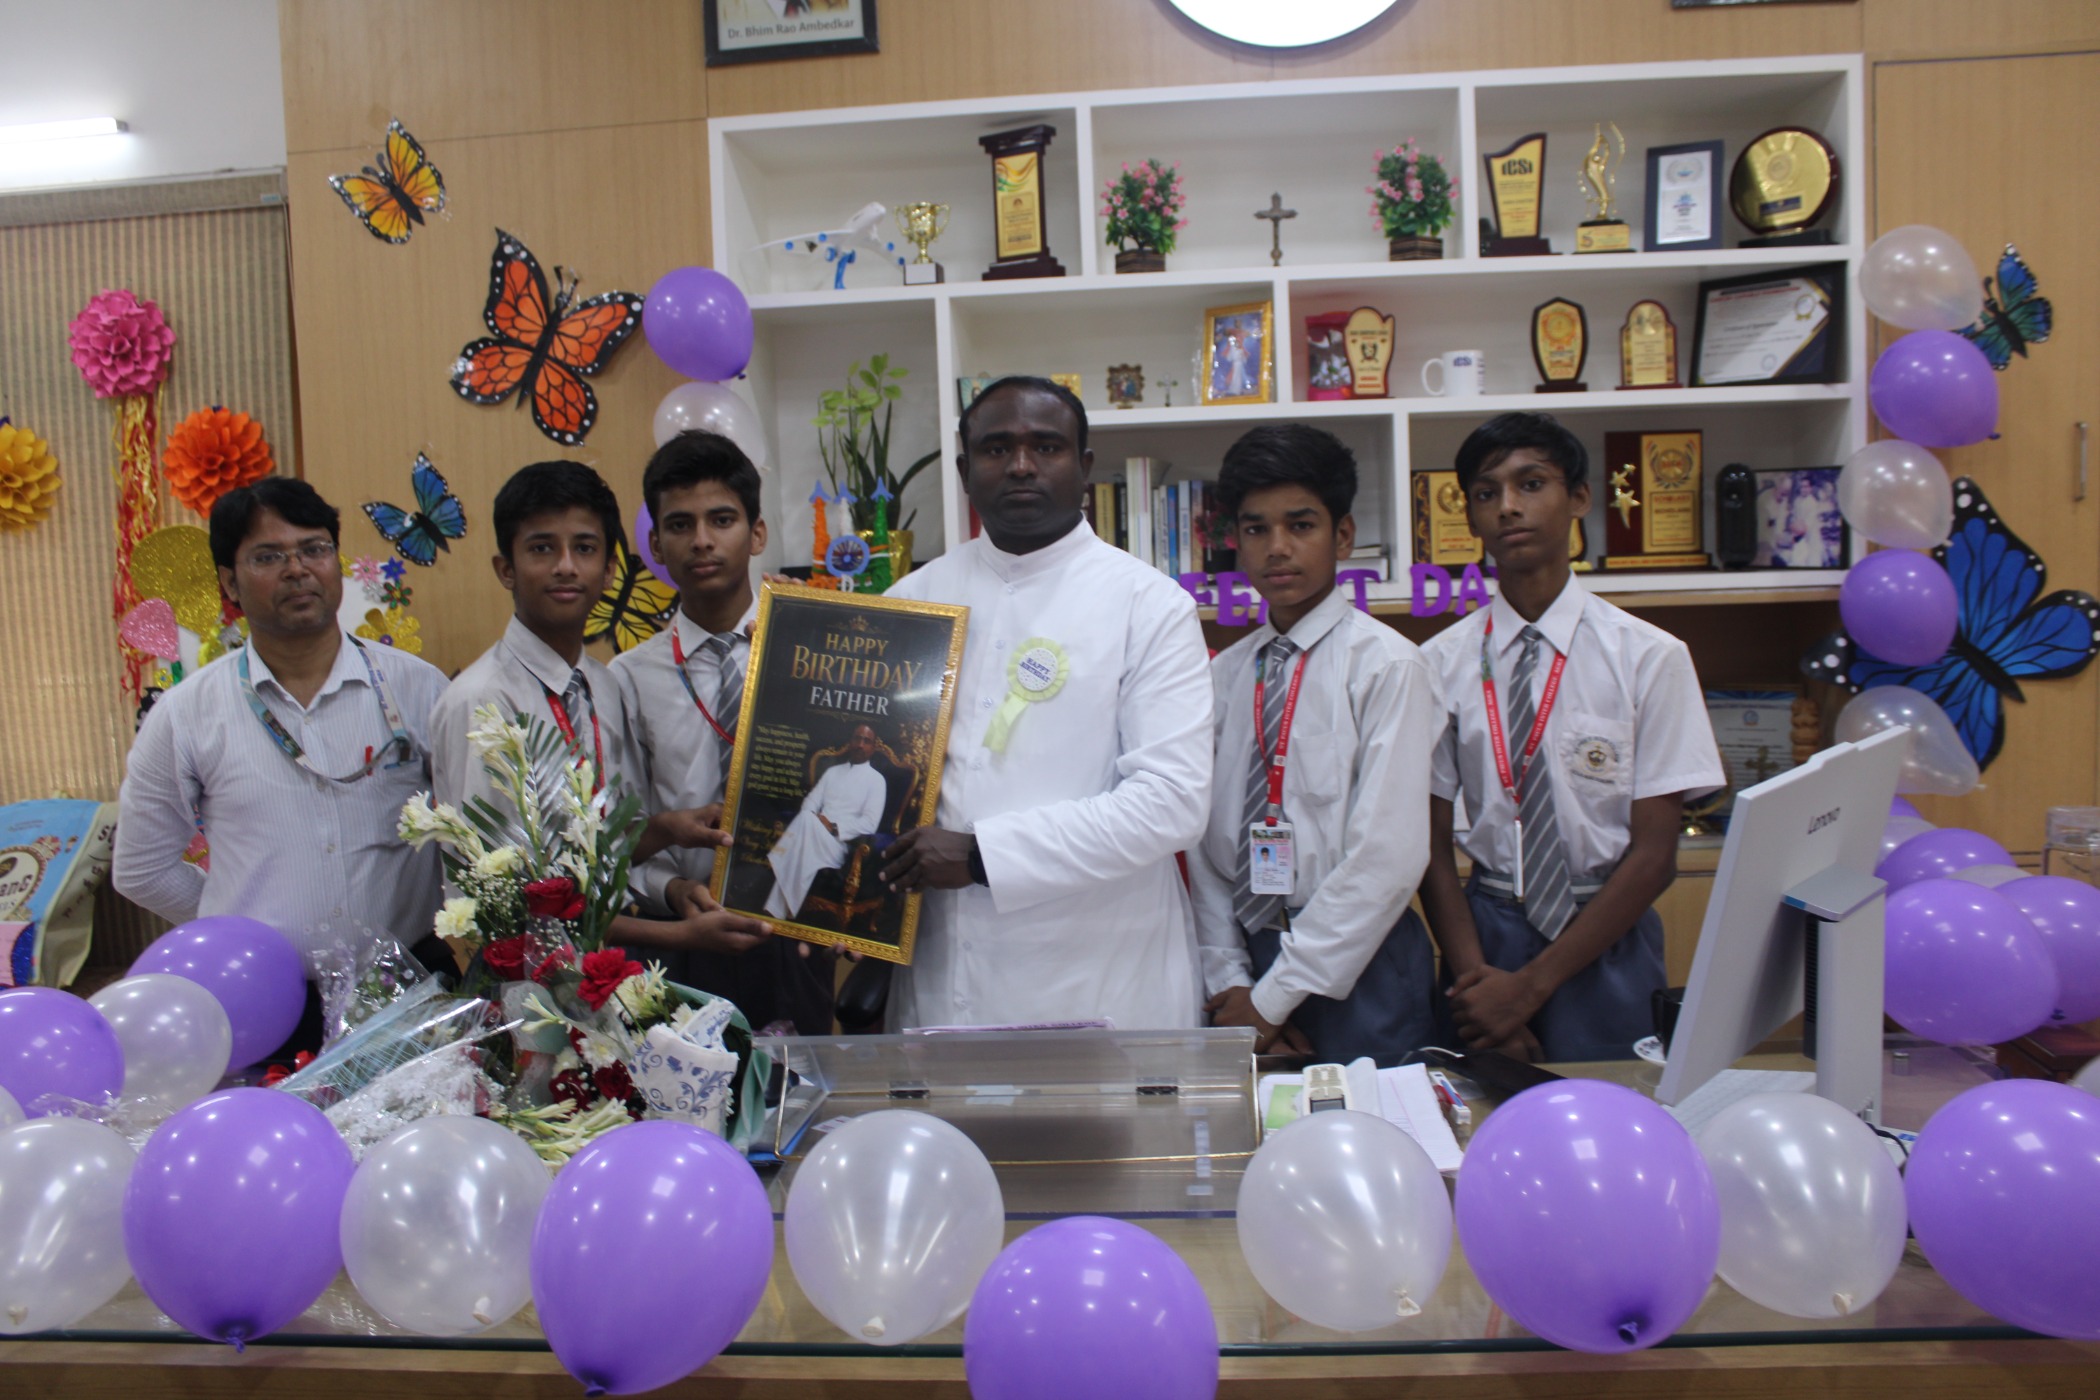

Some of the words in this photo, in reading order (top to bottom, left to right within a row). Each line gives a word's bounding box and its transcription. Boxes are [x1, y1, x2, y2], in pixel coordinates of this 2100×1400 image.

[727, 28, 743, 39] Dr.
[745, 26, 774, 38] Bhim
[776, 23, 797, 35] Rao
[799, 18, 855, 32] Ambedkar
[1409, 563, 1499, 618] DA
[825, 632, 889, 656] HAPPY
[790, 644, 922, 692] BIRTHDAY
[809, 685, 889, 716] FATHER
[1807, 806, 1841, 835] Lenovo
